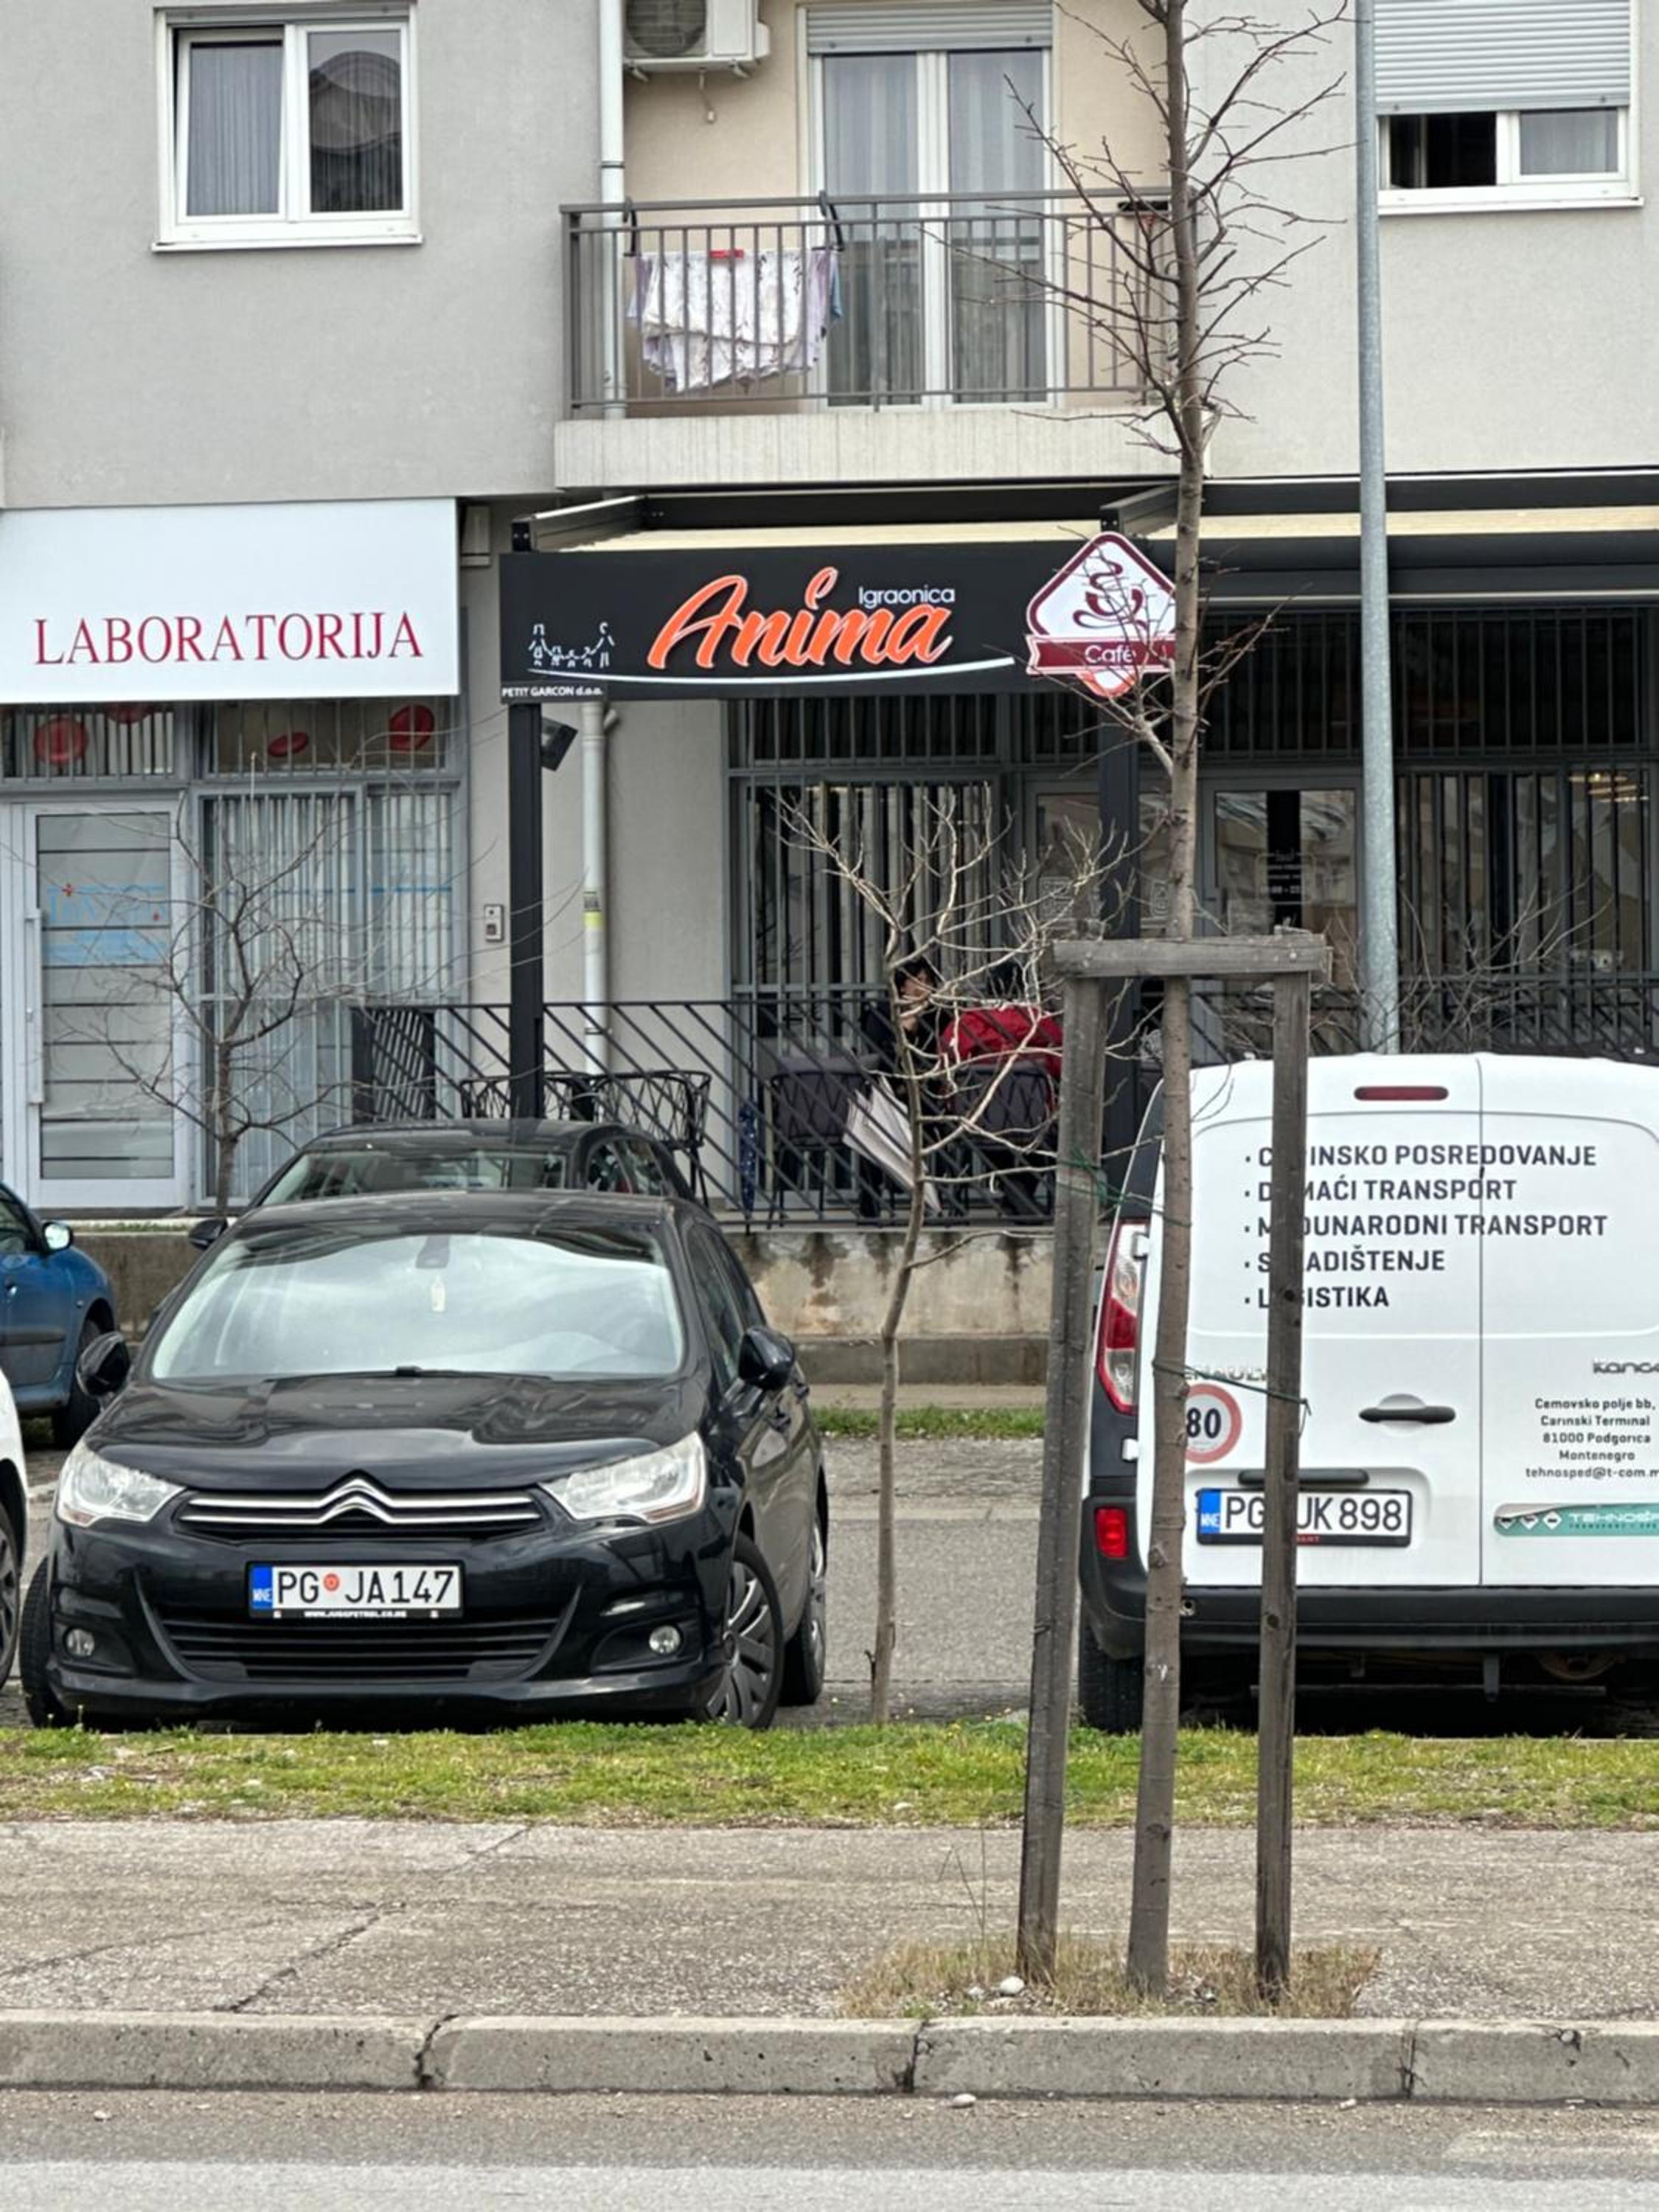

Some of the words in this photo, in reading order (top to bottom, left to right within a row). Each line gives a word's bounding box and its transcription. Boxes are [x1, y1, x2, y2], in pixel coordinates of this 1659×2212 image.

[859, 585, 956, 609] Igraonica
[647, 567, 953, 669] Anima
[35, 612, 423, 664] LABORATORIJA
[1259, 1145, 1387, 1166] CINSKO
[1396, 1144, 1596, 1166] POSREDOVANJE
[1364, 1180, 1517, 1200] TRANSPORT
[1455, 1214, 1607, 1237] TRANSPORT
[1258, 1245, 1444, 1273] SADIŠTENJE
[1259, 1286, 1389, 1309] LISTIKA
[1602, 1398, 1633, 1411] polje
[1187, 1408, 1222, 1439] 80
[1540, 1415, 1592, 1426] Carinski
[1595, 1415, 1650, 1426] Terminal
[1543, 1433, 1585, 1443] 81000
[1587, 1433, 1652, 1446] Podgorica
[1559, 1450, 1635, 1463] Montenegro
[1226, 1496, 1264, 1529] PG
[279, 1571, 319, 1604] PG
[345, 1571, 454, 1604] JA147
